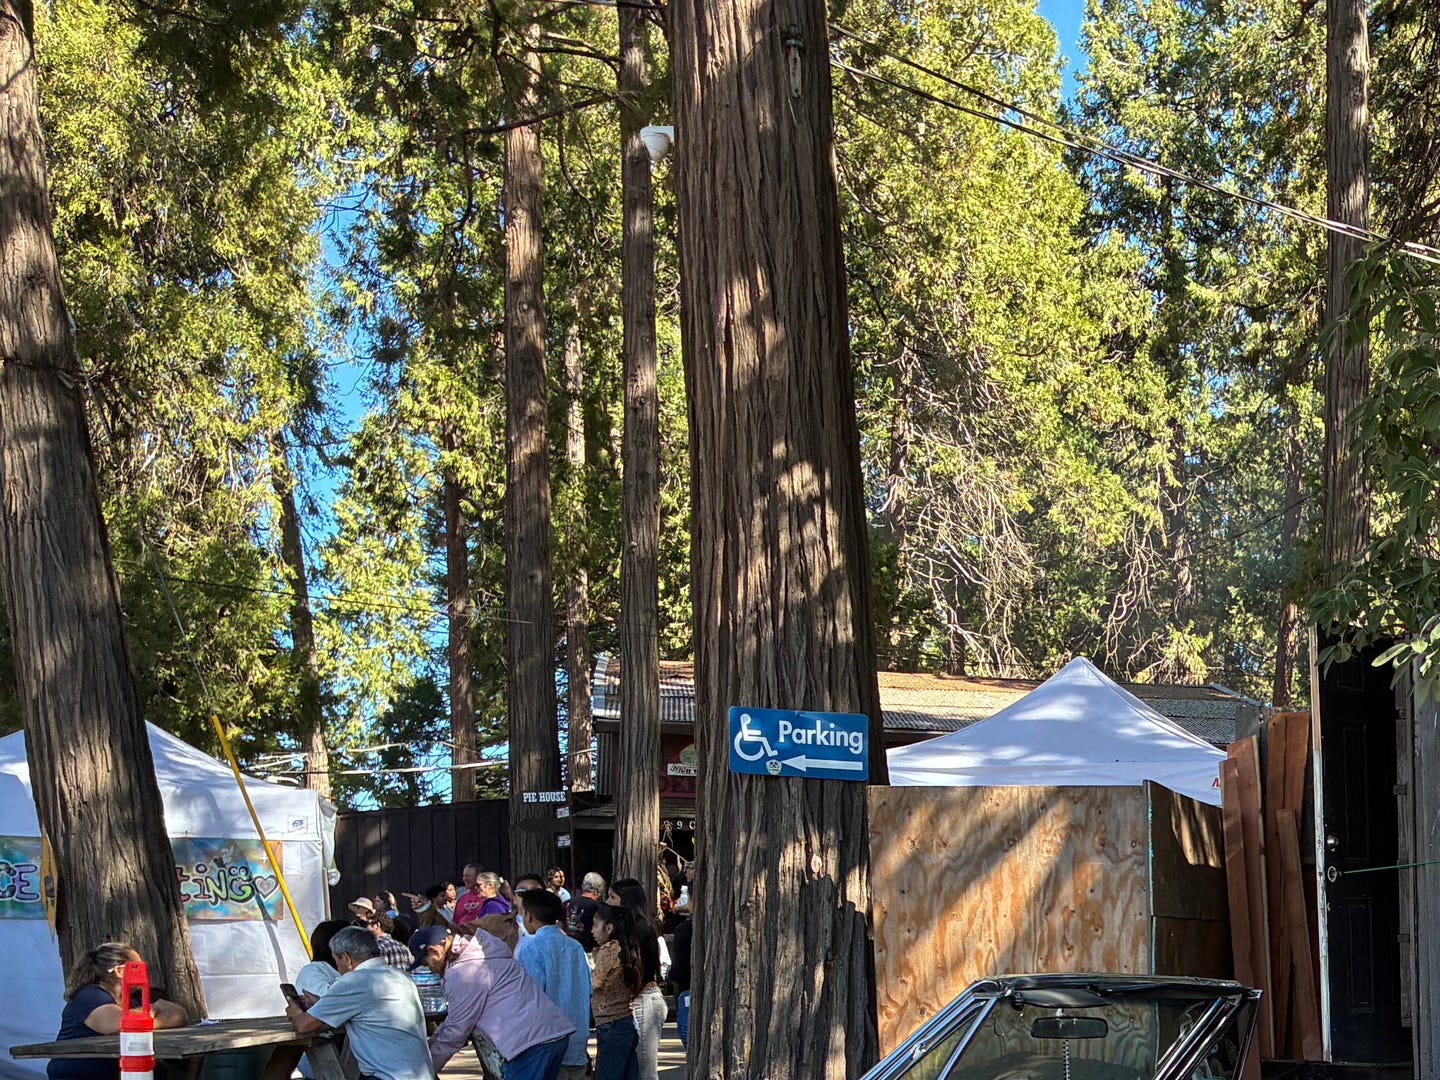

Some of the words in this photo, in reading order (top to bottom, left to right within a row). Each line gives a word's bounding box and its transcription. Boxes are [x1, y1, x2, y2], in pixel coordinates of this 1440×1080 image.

[778, 719, 863, 755] Parking
[523, 792, 537, 802] PIE
[538, 791, 566, 802] HOUSE
